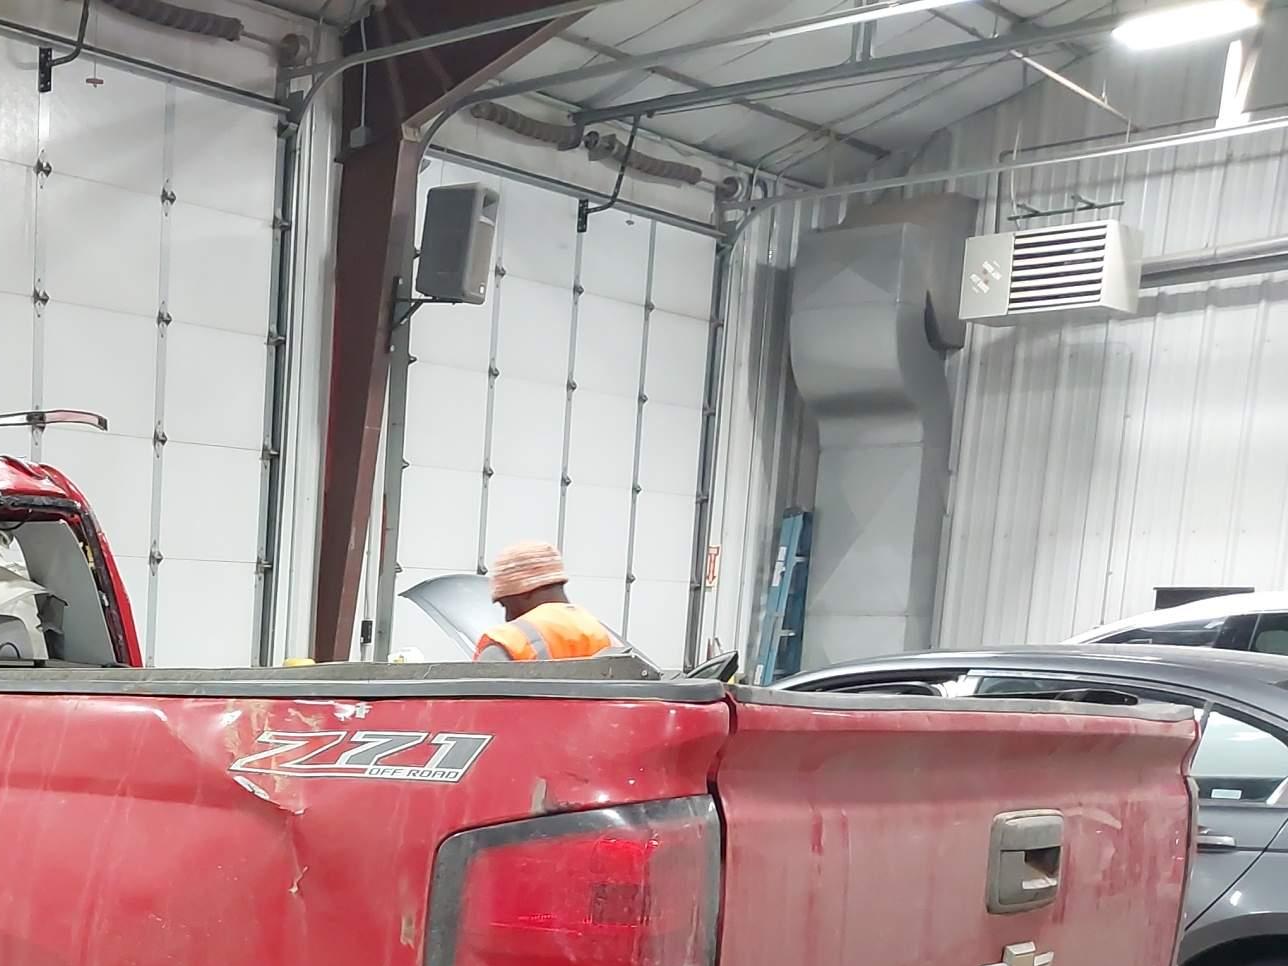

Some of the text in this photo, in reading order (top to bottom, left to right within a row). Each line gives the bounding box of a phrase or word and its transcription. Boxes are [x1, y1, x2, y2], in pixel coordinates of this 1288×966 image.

[227, 729, 496, 772] Z71
[367, 766, 461, 780] OFF ROAD
